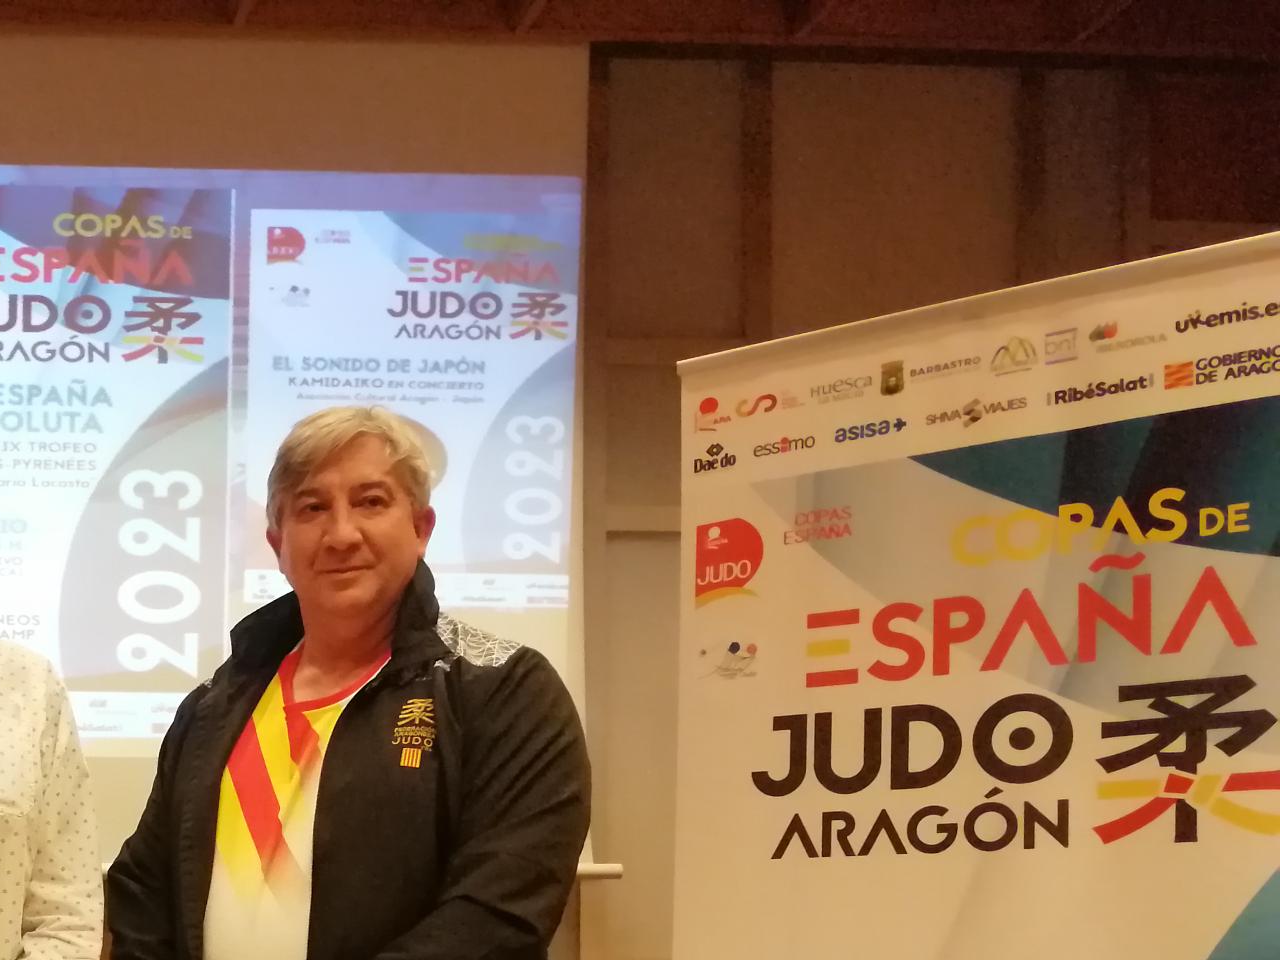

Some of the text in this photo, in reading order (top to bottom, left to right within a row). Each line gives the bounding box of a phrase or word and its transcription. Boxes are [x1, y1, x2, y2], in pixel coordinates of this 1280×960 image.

[53, 214, 192, 239] COPAS DE
[408, 253, 561, 284] ESPAÑA
[387, 291, 503, 319] JUDO
[395, 323, 501, 340] ARAGÓN
[273, 355, 485, 375] EL SONIDO DE JAPÓN
[910, 356, 981, 377] BARBASTRO
[1196, 372, 1218, 384] DE
[984, 397, 1027, 414] VIAJES
[504, 416, 565, 563] 2023
[950, 487, 1251, 568] COPAS DE
[116, 469, 203, 678] 2023
[697, 560, 752, 585] JUDO
[806, 552, 1258, 688] ESPAÑA
[392, 737, 432, 747] JUDO
[751, 693, 1074, 797] JUDO
[770, 787, 1069, 859] ARAGÓN
